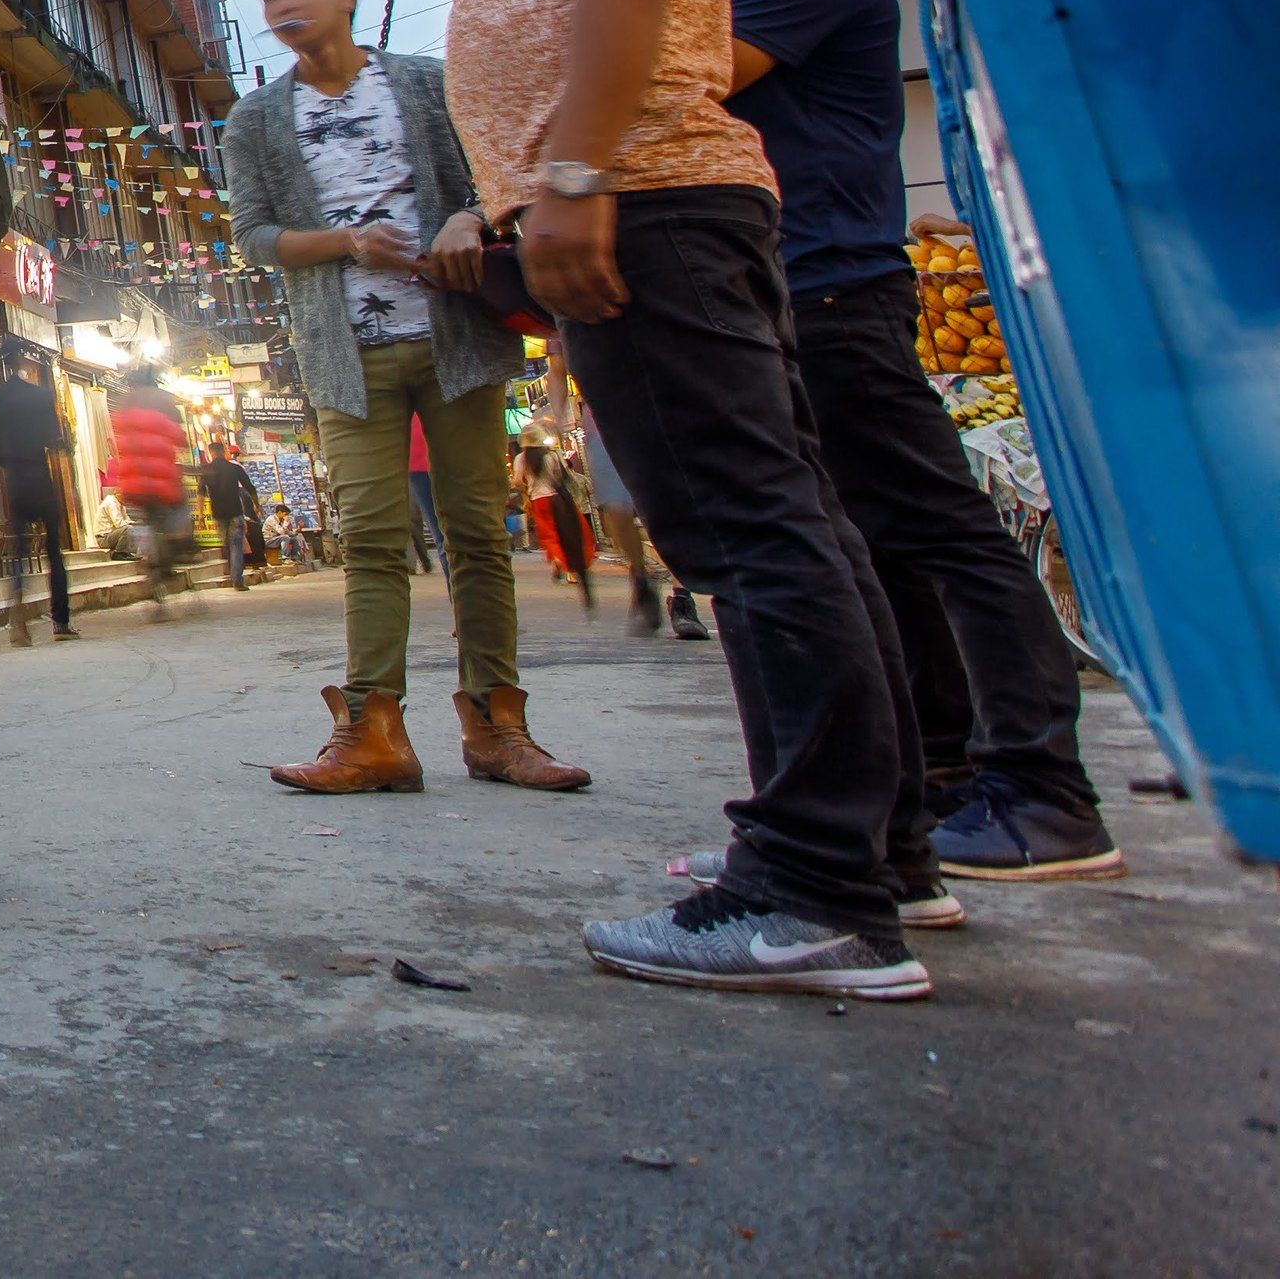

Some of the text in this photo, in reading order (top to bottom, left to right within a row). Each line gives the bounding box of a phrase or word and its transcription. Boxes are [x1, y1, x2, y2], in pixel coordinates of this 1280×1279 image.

[241, 397, 304, 411] GRAND BOOKS SHOP
